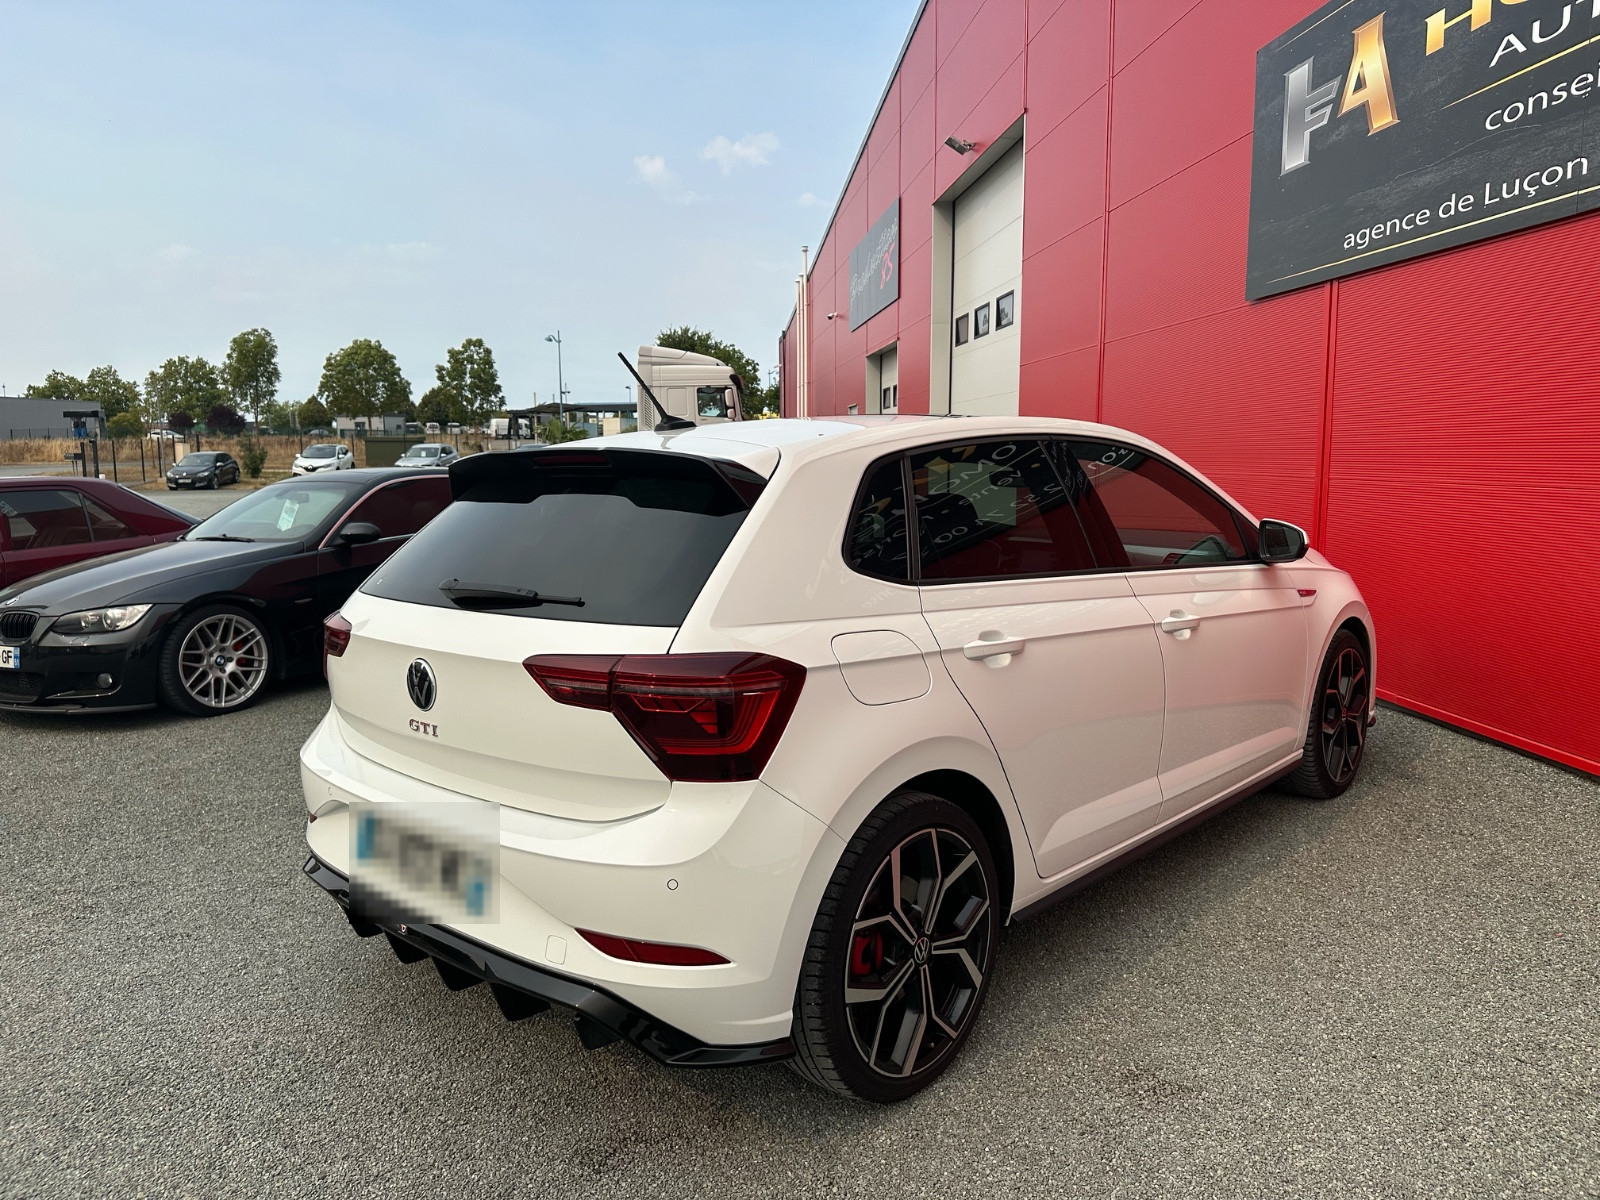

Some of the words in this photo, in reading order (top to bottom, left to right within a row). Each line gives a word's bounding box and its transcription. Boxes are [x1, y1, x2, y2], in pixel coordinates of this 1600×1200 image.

[1343, 209, 1431, 250] agence
[1438, 194, 1475, 219] de
[1484, 156, 1589, 208] Luçon
[409, 719, 438, 738] GTI
